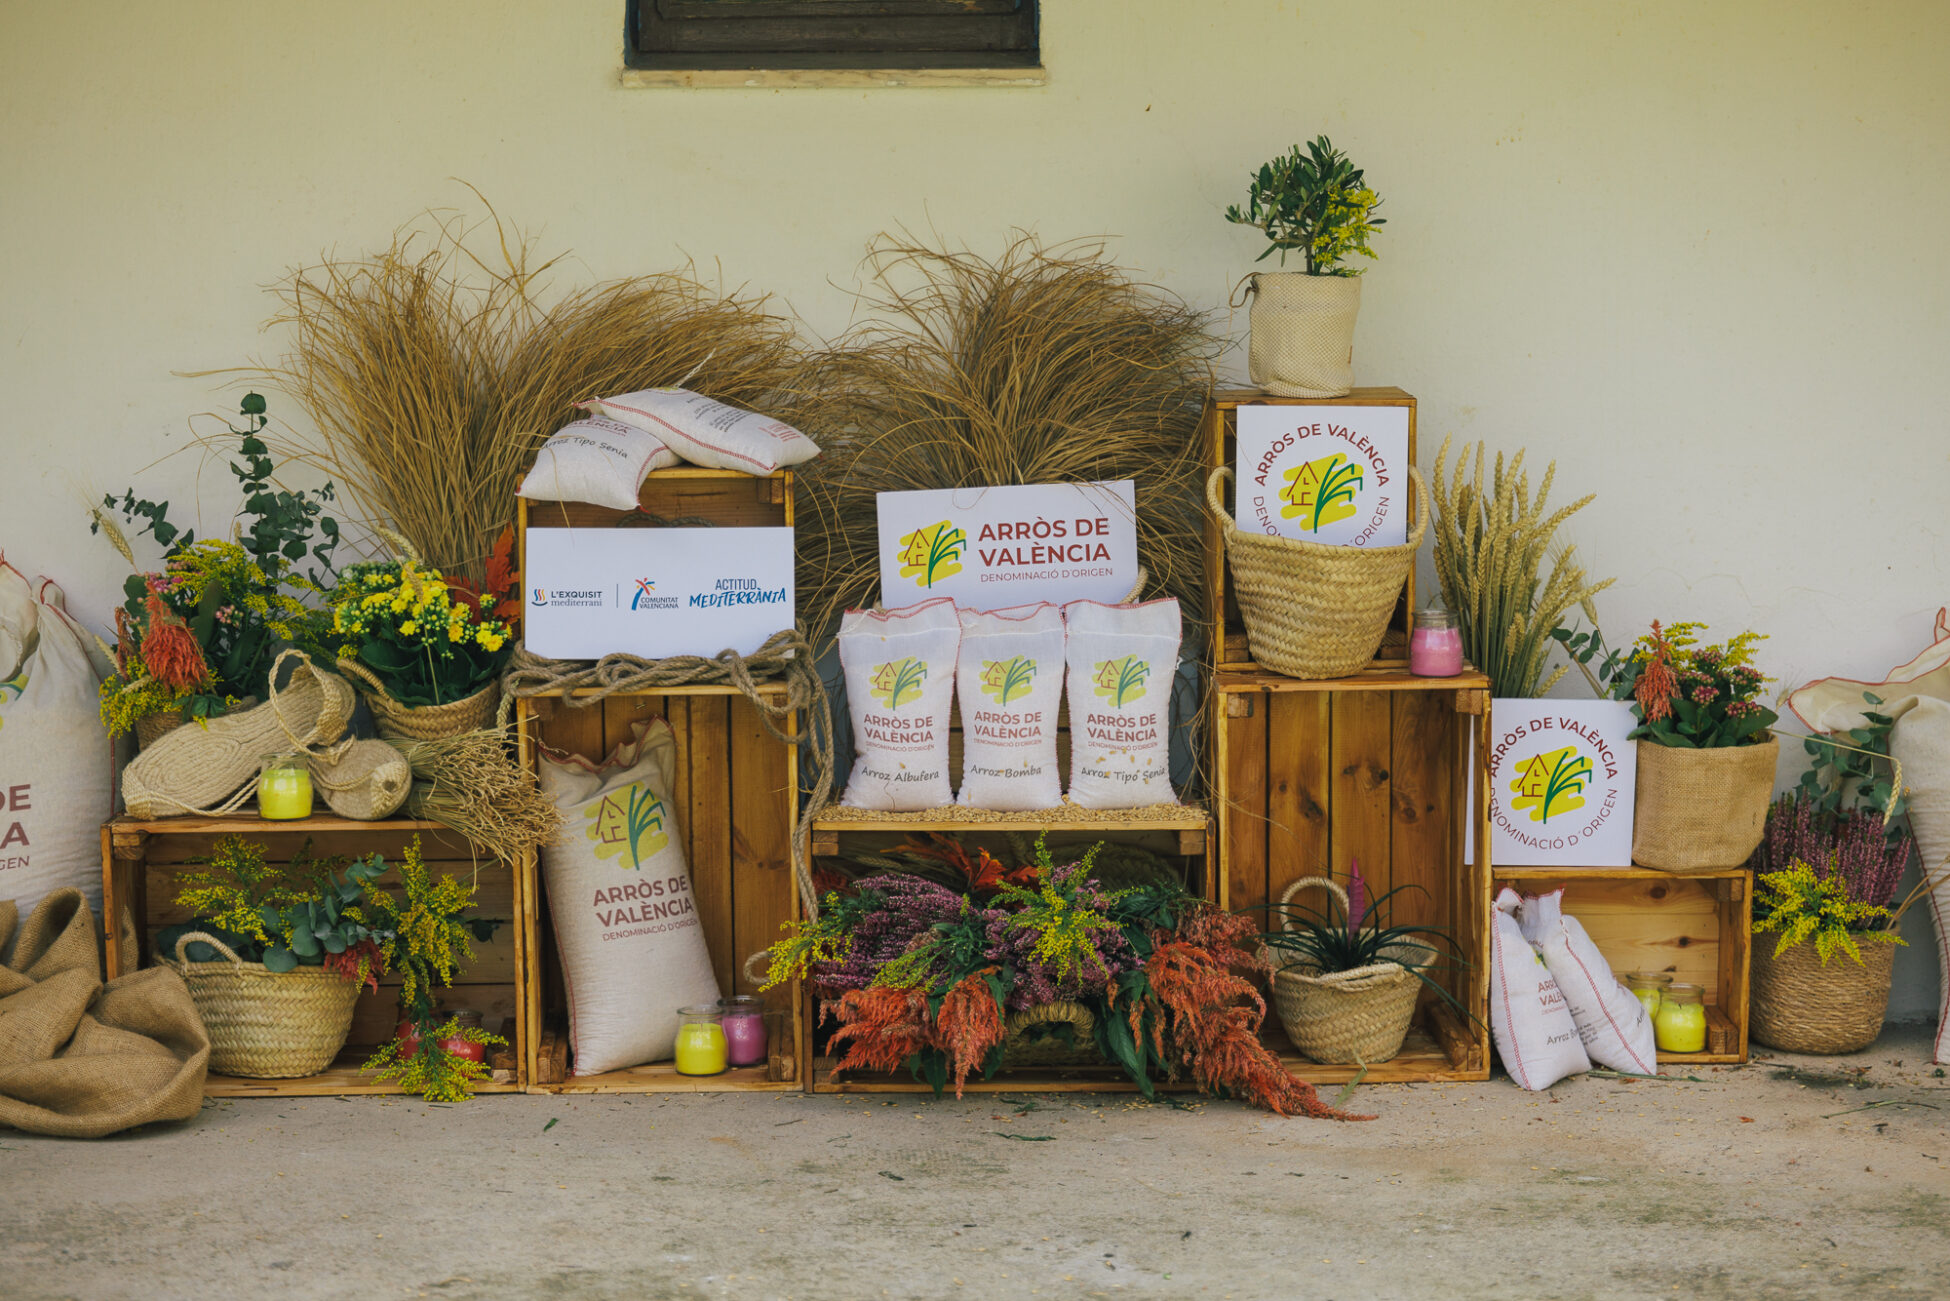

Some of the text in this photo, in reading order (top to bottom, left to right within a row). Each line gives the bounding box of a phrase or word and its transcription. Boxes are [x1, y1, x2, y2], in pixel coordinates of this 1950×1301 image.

[573, 436, 596, 447] Tipo
[1254, 423, 1390, 487] ARRÒS DE VALÈNCIA
[978, 516, 1110, 542] ARRÒS DE
[1342, 496, 1390, 546] 'ORIGEN
[978, 541, 1111, 567] VALÈNCIA
[715, 578, 757, 590] ACTITUD
[980, 569, 1059, 583] DENOMINACIÓ
[550, 599, 602, 607] mediterrani
[551, 591, 603, 599] L'EXQUISIT
[689, 587, 786, 608] MEDITERRÀNIA
[863, 713, 933, 729] ARRÒS DE
[974, 711, 1042, 725] ARRÒS DE
[1087, 713, 1157, 728] ARRÒS DE
[864, 726, 934, 743] VALÈNCIA
[974, 724, 1042, 739] VALÈNCIA
[1087, 727, 1157, 742] VALÈNCIA
[1491, 717, 1618, 779] ARRÒS DE VALÈNCIA
[861, 766, 940, 782] Arroz Albufera
[970, 764, 1042, 778] Arroz Bomba
[1113, 771, 1138, 784] Tipo
[0, 784, 31, 811] E
[593, 875, 688, 907] ARRÒS DE
[596, 897, 694, 927] VALÈNCIA
[602, 924, 667, 941] DENOMINACIÓ
